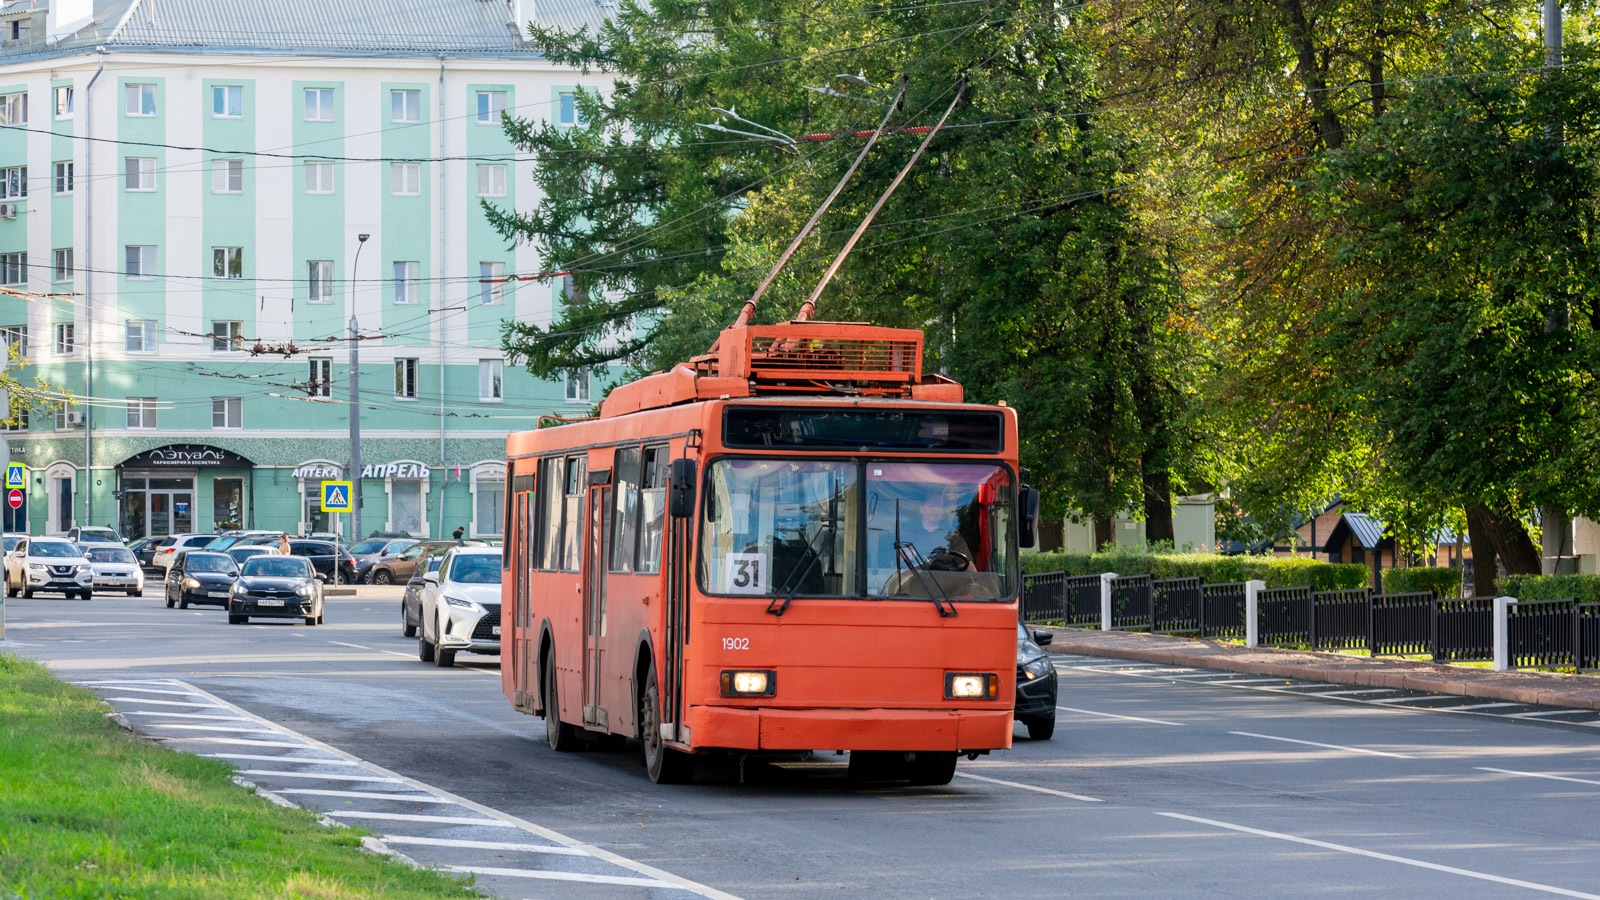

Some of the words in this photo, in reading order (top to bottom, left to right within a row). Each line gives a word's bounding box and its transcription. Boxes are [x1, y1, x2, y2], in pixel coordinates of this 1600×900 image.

[291, 468, 338, 478] АПТЕКА
[361, 464, 431, 478] АПРЕЛЬ
[733, 559, 759, 588] 31
[722, 637, 750, 650] 1902
